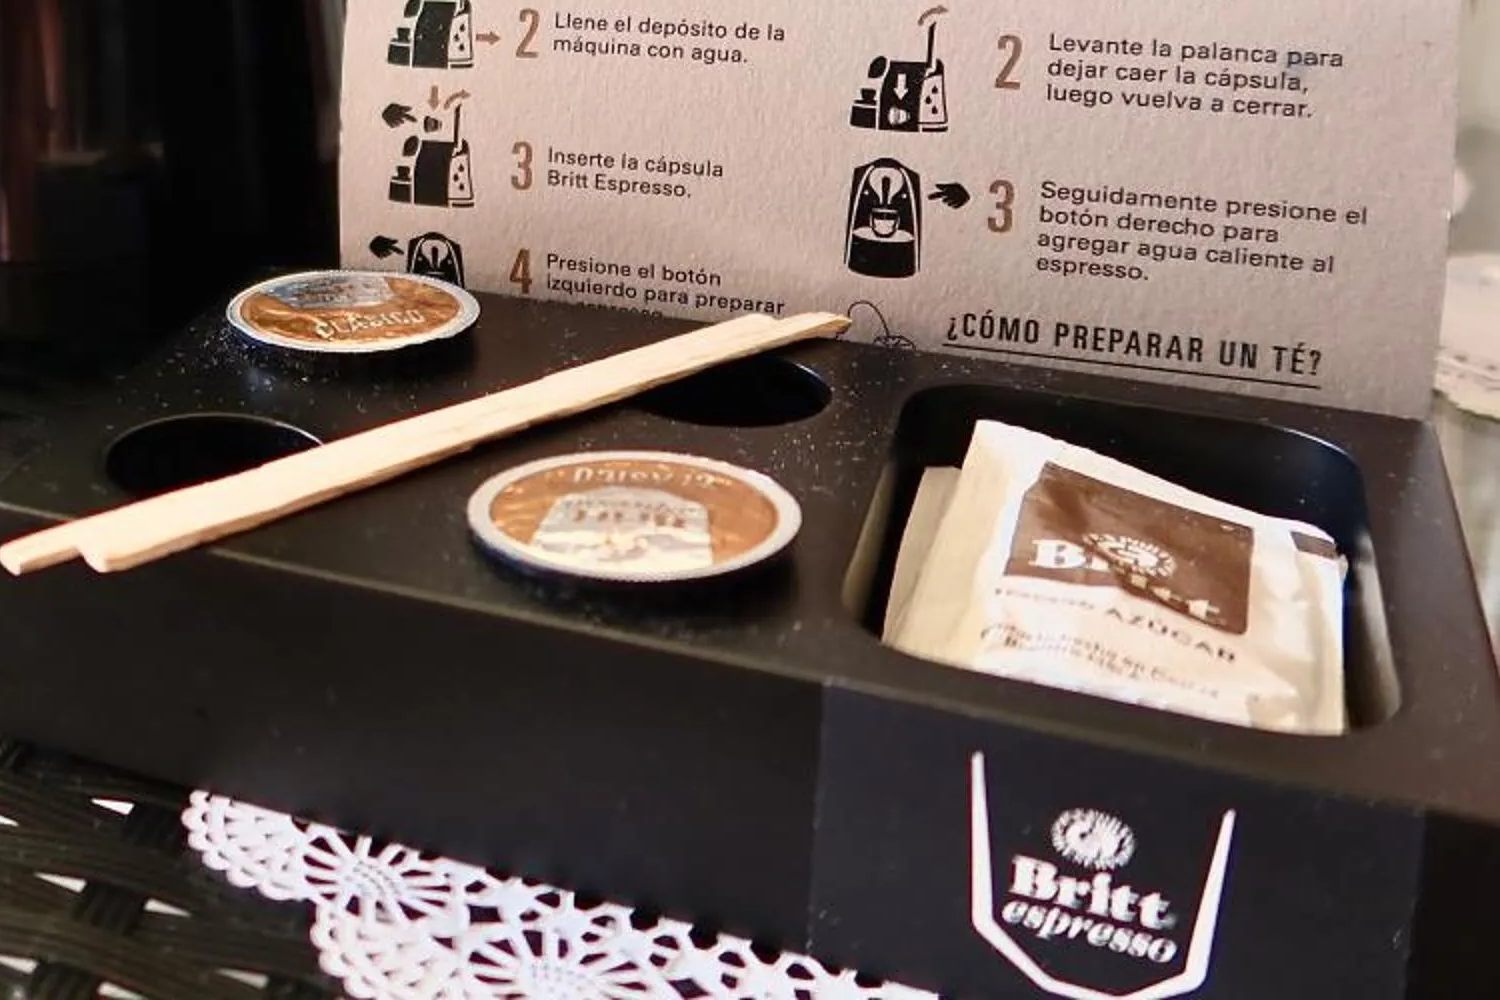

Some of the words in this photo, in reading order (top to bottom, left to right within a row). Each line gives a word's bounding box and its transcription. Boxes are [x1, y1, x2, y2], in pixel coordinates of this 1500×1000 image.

[515, 8, 541, 59] 2
[554, 12, 608, 31] Llene
[614, 16, 631, 32] el
[638, 17, 727, 43] depósito
[734, 22, 760, 40] de
[767, 24, 785, 42] la
[553, 35, 641, 57] máquina
[647, 44, 684, 59] con
[691, 46, 748, 64] agua.
[995, 34, 1024, 91] 2
[1049, 33, 1143, 56] Levante
[1151, 39, 1172, 57] la
[1181, 42, 1278, 63] palanca
[1286, 50, 1344, 69] para
[1047, 58, 1108, 82] dejar
[1115, 66, 1168, 83] caer
[1175, 66, 1196, 85] la
[1204, 67, 1309, 94] cápsula,
[1046, 83, 1113, 108] luego
[1121, 90, 1202, 111] vuelva
[1211, 98, 1224, 113] a
[1232, 98, 1313, 119] cerrar.
[511, 141, 533, 191] 3
[547, 146, 615, 169] Inserte
[621, 151, 638, 171] la
[645, 156, 724, 177] cápsula
[547, 169, 588, 189] Britt
[595, 173, 692, 199] Espresso.
[1040, 180, 1218, 213] Seguidamente
[1225, 200, 1338, 224] presione
[1345, 205, 1368, 225] el
[987, 178, 1016, 233] 3
[1039, 205, 1109, 229] botón
[1116, 210, 1215, 238] derecho
[1223, 224, 1280, 244] para
[509, 248, 533, 295] 4
[547, 253, 631, 277] Presione
[638, 263, 655, 279] el
[662, 265, 721, 286] botón
[1036, 257, 1150, 281] espresso.
[1037, 231, 1132, 256] agregar
[1137, 242, 1198, 262] agua
[1205, 245, 1304, 271] caliente
[1312, 255, 1334, 273] al
[547, 273, 637, 298] izquierdo
[643, 288, 688, 308] para
[695, 292, 786, 315] preparar
[946, 309, 1040, 344] ¿CÓMO
[1054, 322, 1204, 363] PREPARAR
[1218, 340, 1258, 369] UN
[1273, 341, 1323, 377] TÉ?
[1007, 853, 1177, 929] Britt
[1001, 900, 1178, 963] espresso
